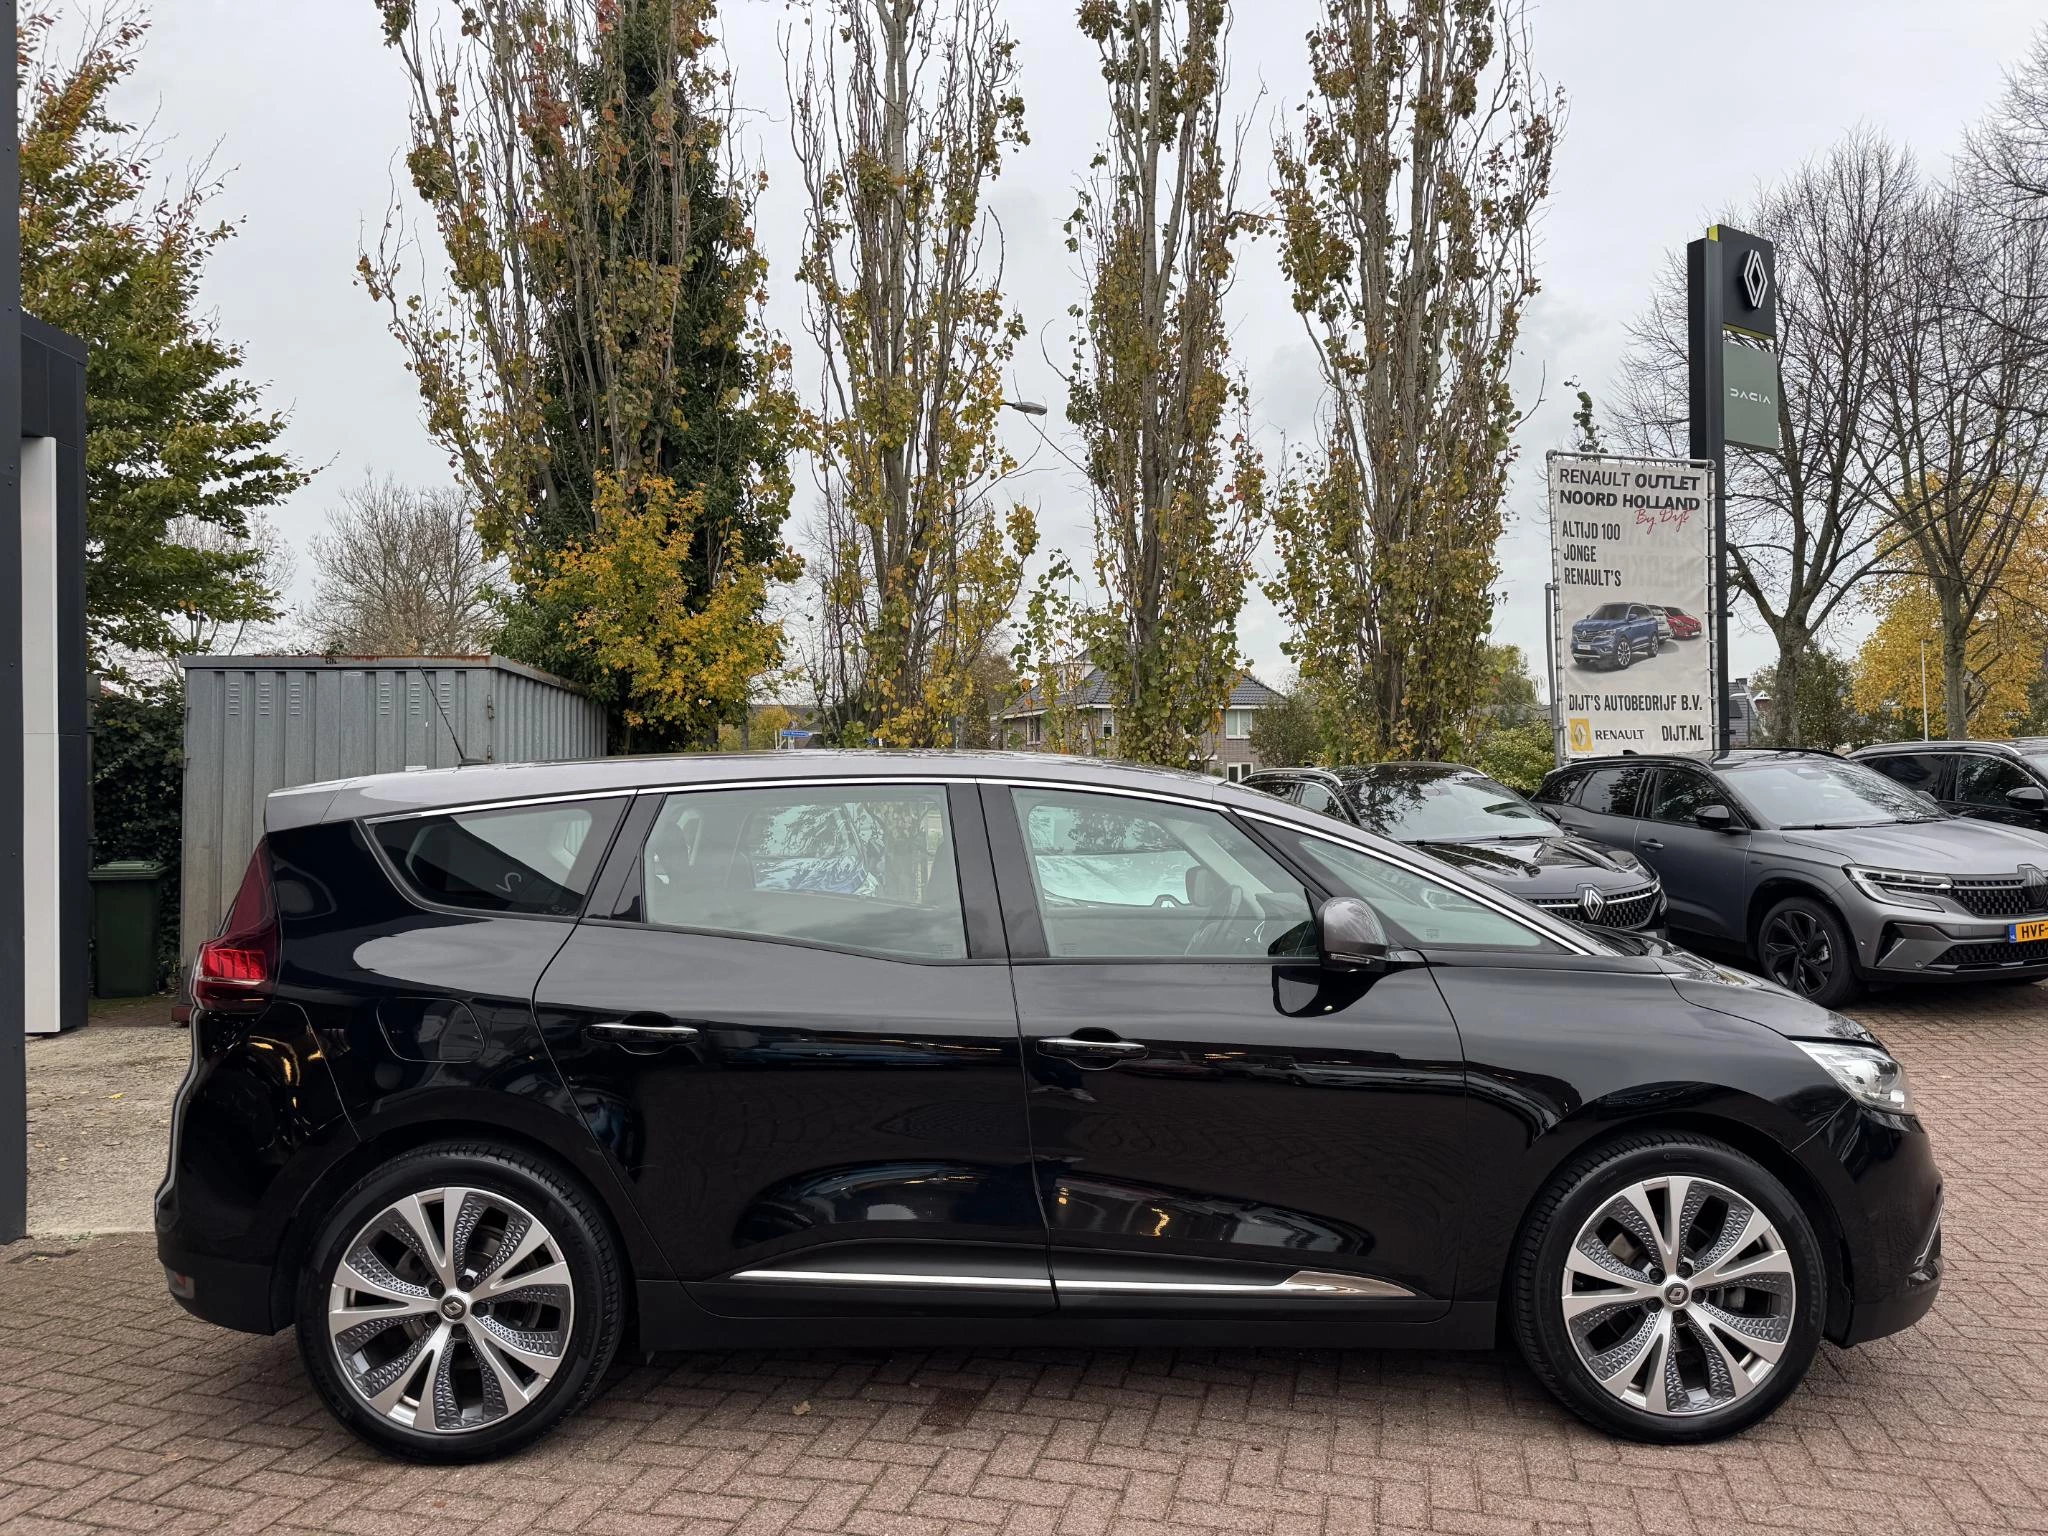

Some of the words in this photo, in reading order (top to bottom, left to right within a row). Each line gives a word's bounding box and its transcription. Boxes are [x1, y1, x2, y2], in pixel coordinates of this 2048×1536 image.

[1730, 387, 1771, 405] DACIA
[1560, 468, 1631, 488] RENAULT
[1635, 473, 1701, 491] OUTLET
[1560, 490, 1618, 507] NOORD
[1622, 493, 1701, 511] HOLLAND
[1562, 520, 1599, 540] ALTIJD
[1601, 523, 1621, 541] 100
[1634, 508, 1656, 534] By
[1563, 544, 1597, 562] JONGE
[1564, 567, 1622, 587] RENAULT'S
[1568, 694, 1601, 712] DIJT'S
[1604, 694, 1677, 712] AUTOBEDRIJF
[1681, 694, 1703, 711] B.V.
[1595, 729, 1645, 740] RENAULT
[1661, 725, 1704, 742] DIJT.NL
